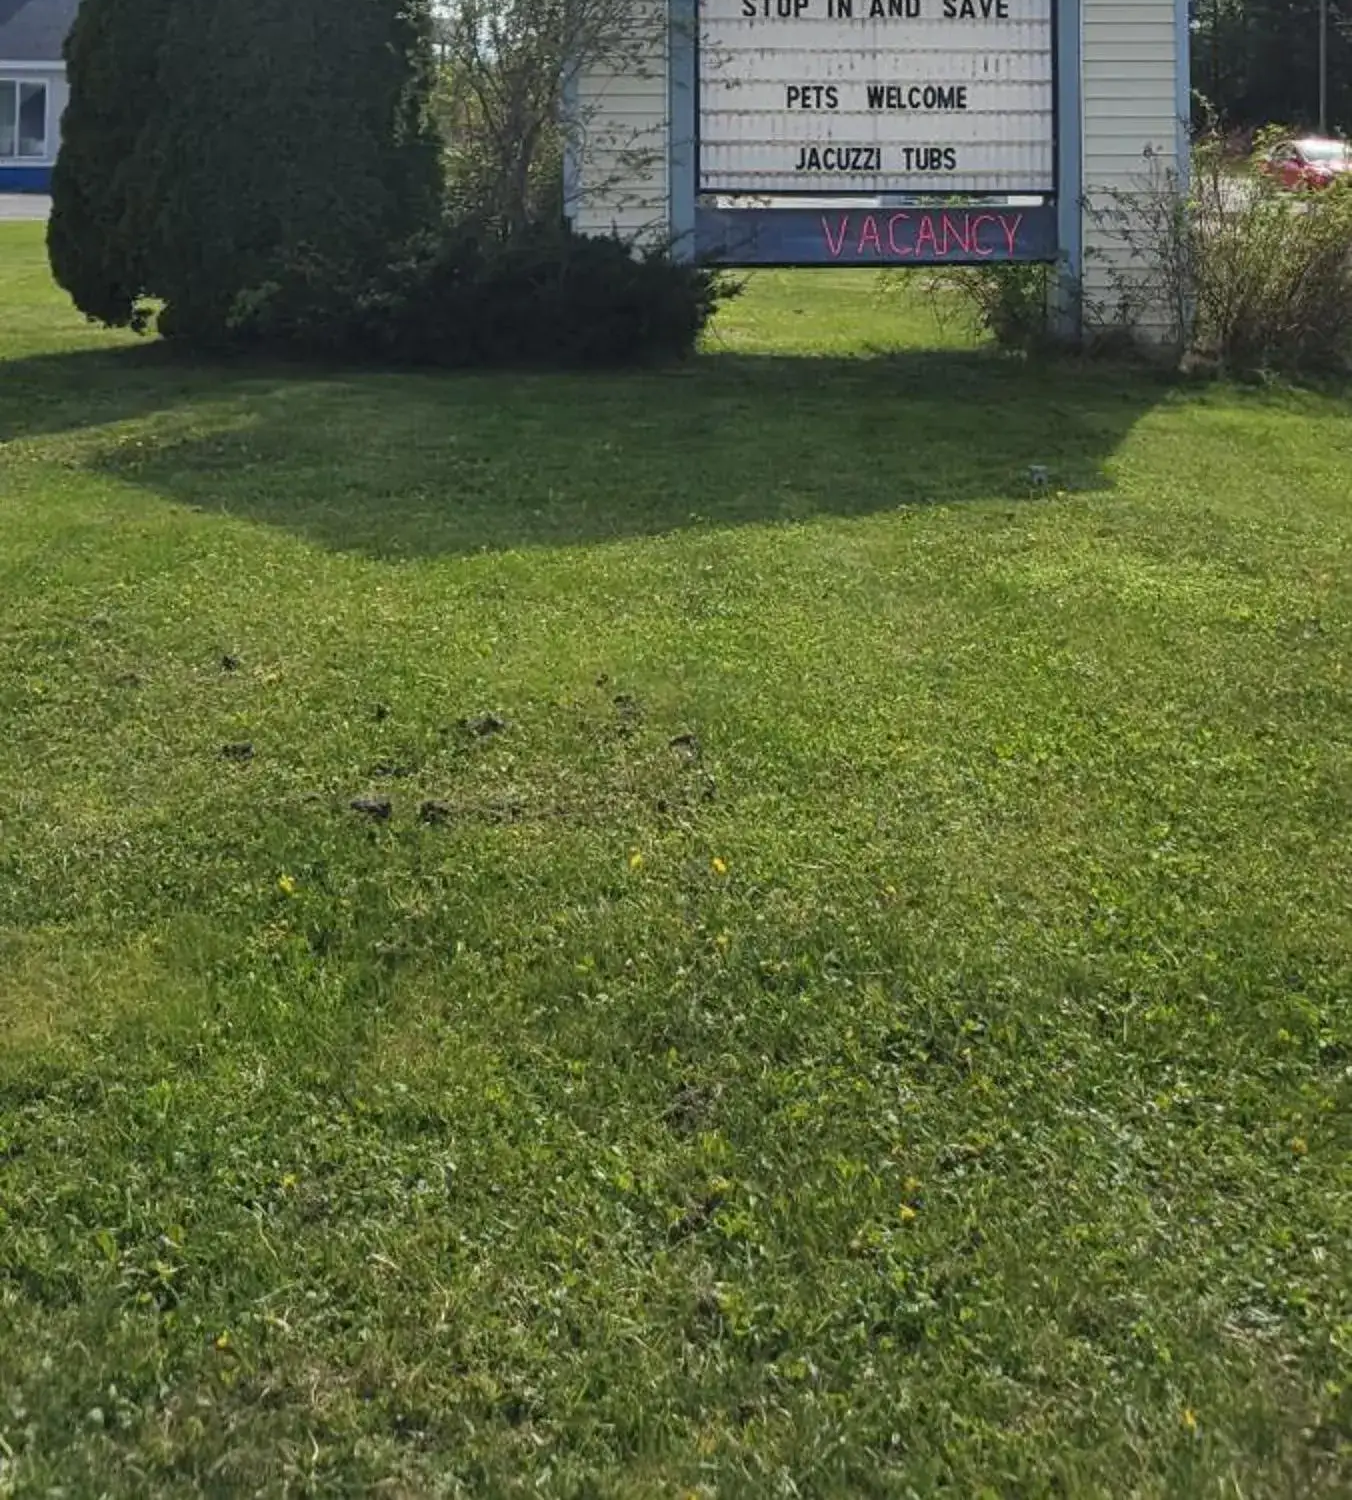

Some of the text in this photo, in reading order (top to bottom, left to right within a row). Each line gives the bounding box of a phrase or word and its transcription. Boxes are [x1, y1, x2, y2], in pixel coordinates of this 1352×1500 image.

[786, 86, 967, 109] PETS WELCOME
[795, 147, 957, 171] JACUZZI TUBS
[822, 213, 1023, 257] VACANCY
